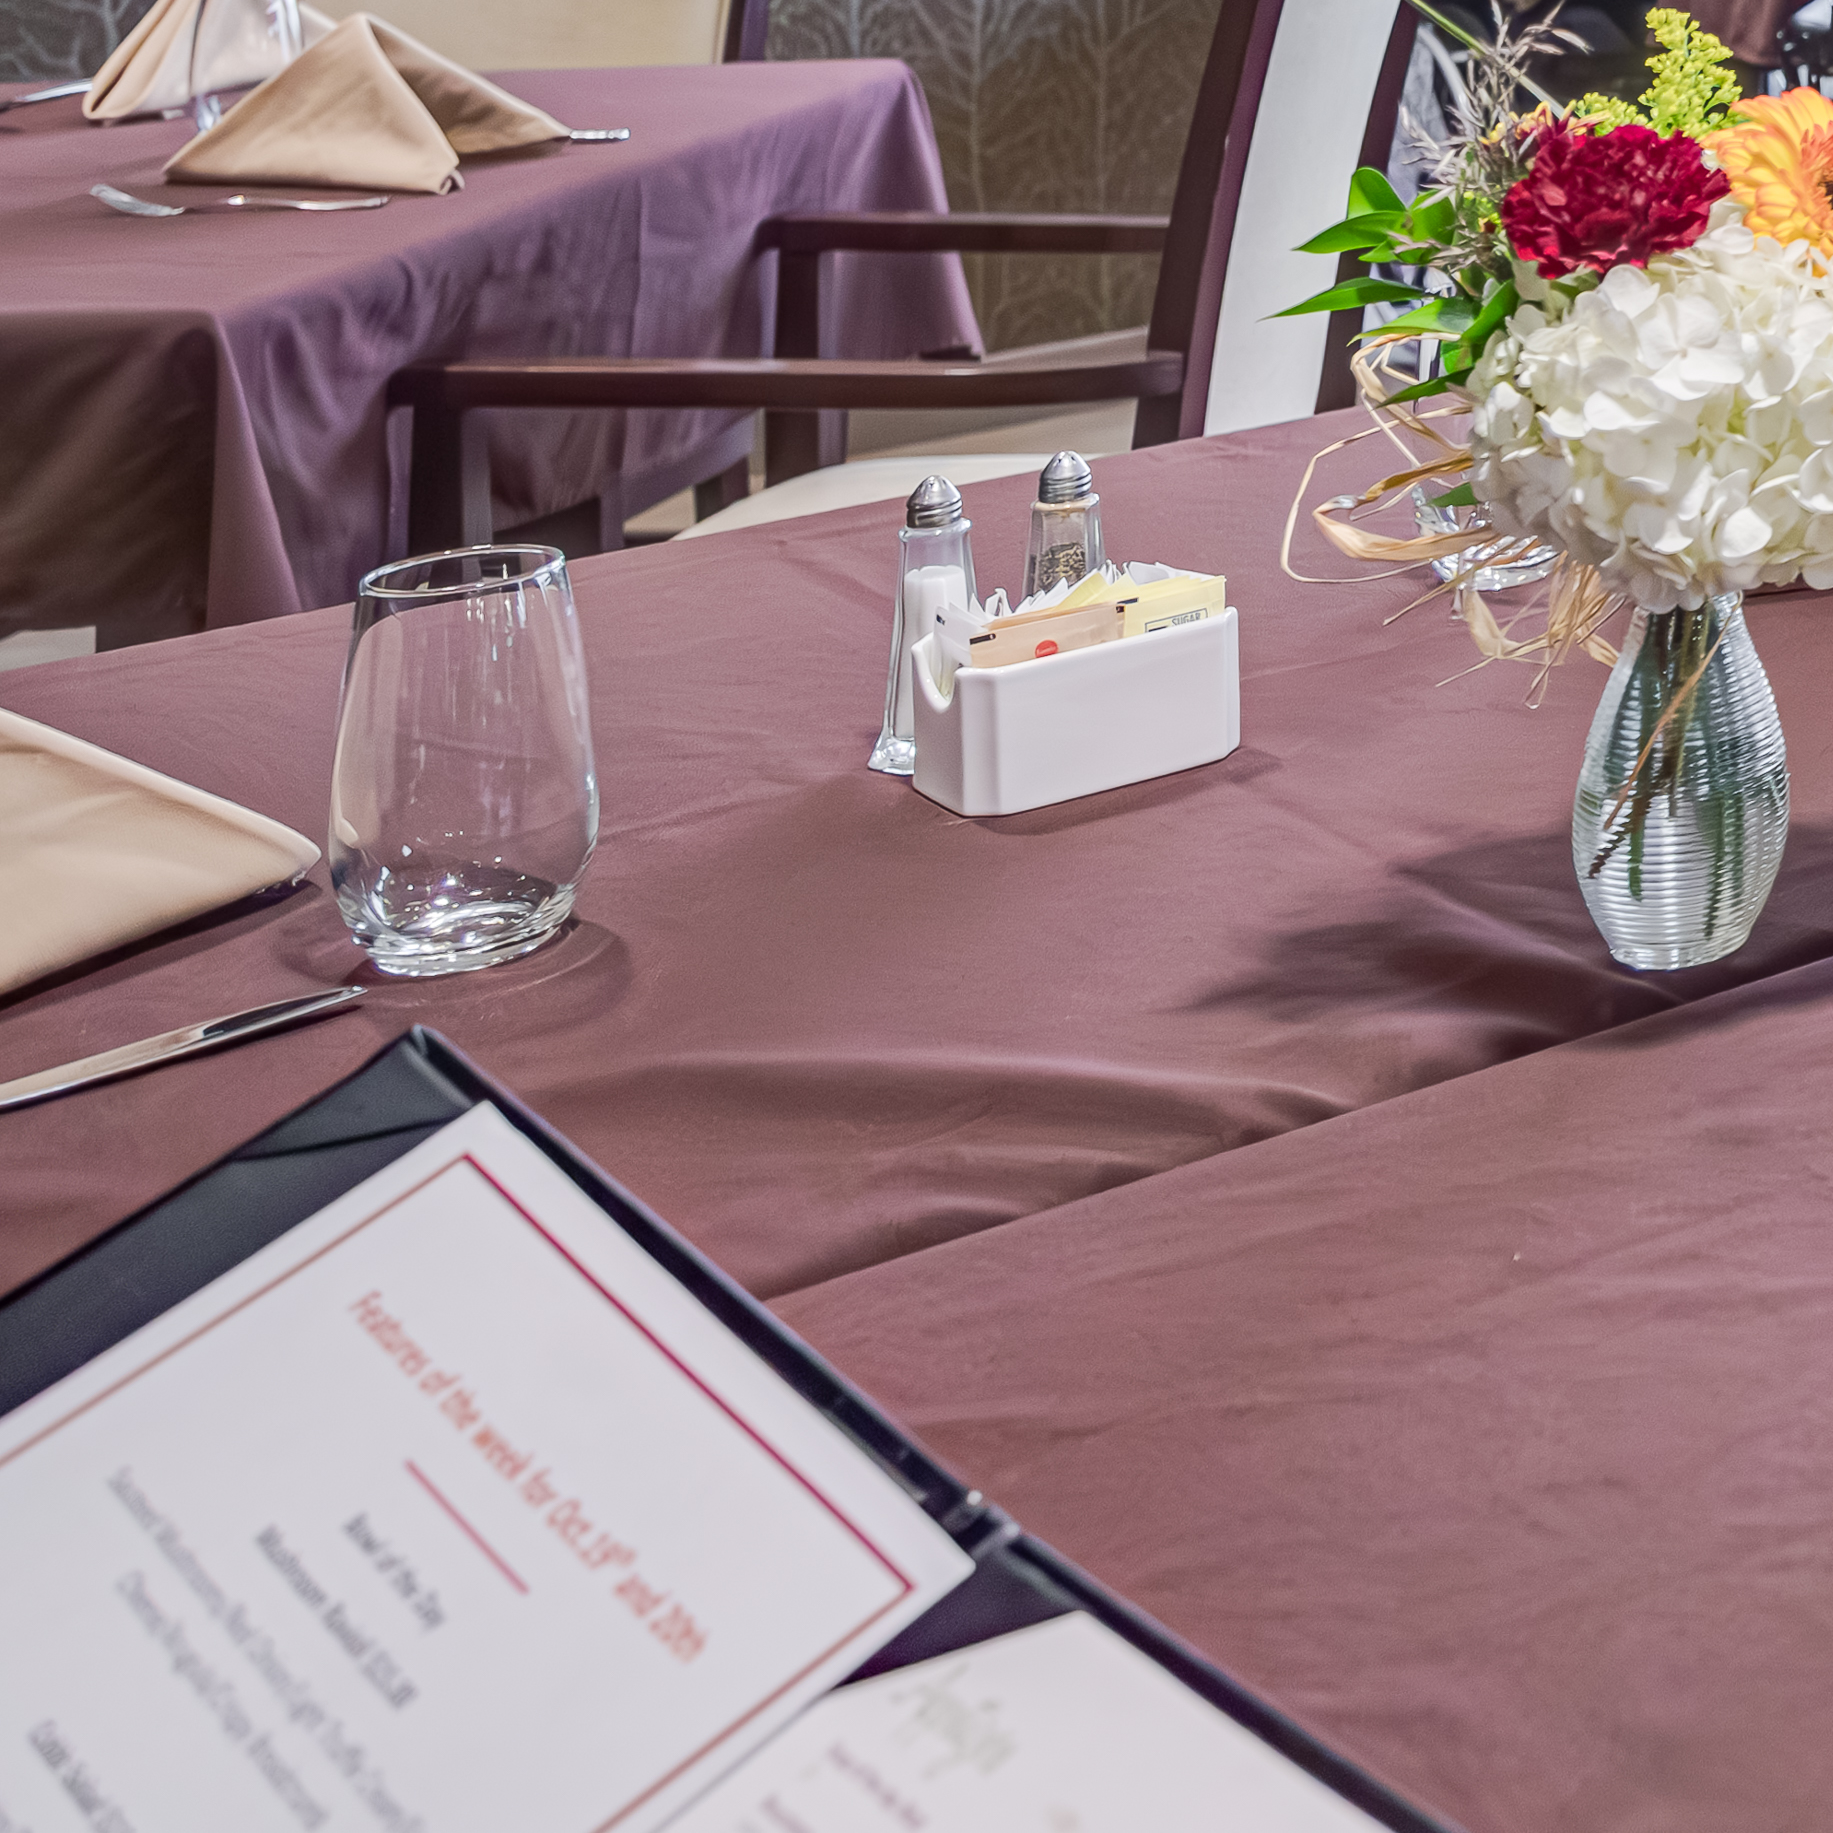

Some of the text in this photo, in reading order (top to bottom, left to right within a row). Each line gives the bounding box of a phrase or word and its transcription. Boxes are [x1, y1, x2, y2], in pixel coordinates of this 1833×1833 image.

[348, 1288, 432, 1379] Features
[417, 1369, 462, 1398] of
[438, 1387, 483, 1432] the
[470, 1421, 535, 1483] week
[520, 1467, 558, 1510] for
[613, 1571, 672, 1619] and
